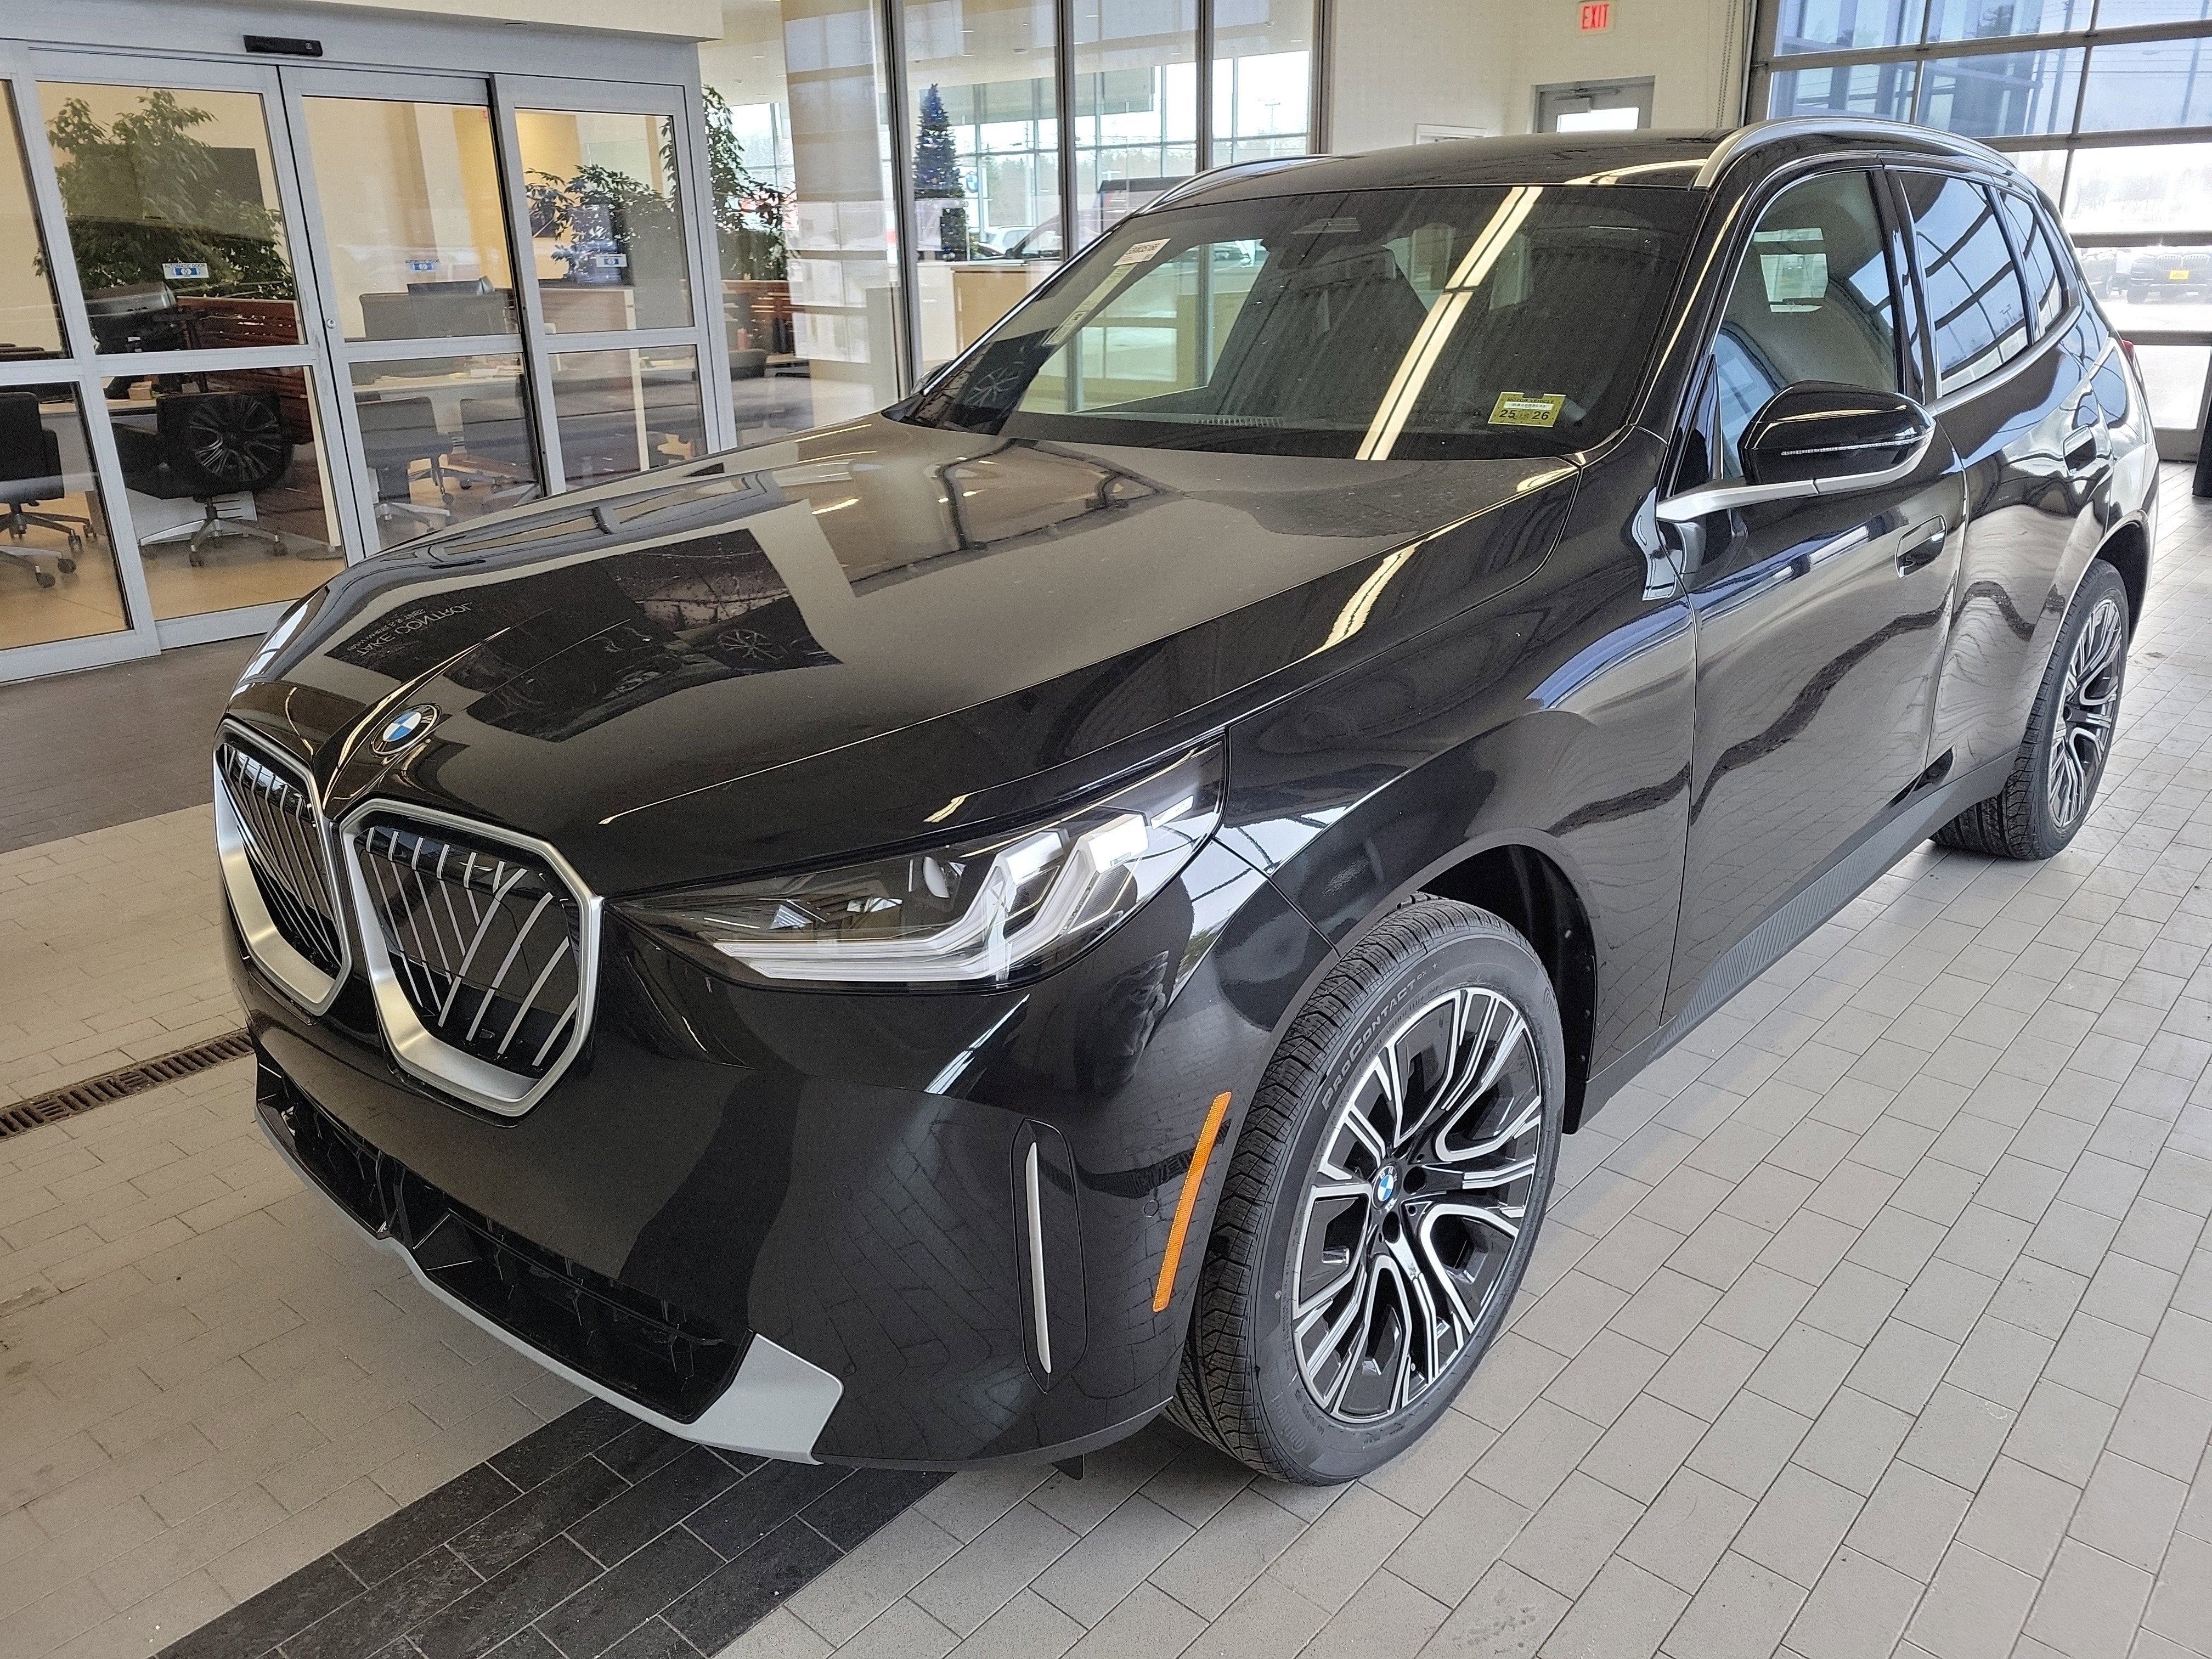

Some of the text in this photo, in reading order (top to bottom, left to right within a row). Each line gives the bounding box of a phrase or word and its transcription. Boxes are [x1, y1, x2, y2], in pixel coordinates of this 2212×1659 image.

[1582, 4, 1609, 29] EXIT
[1499, 409, 1550, 420] 25 26
[1379, 1167, 1398, 1182] BMW
